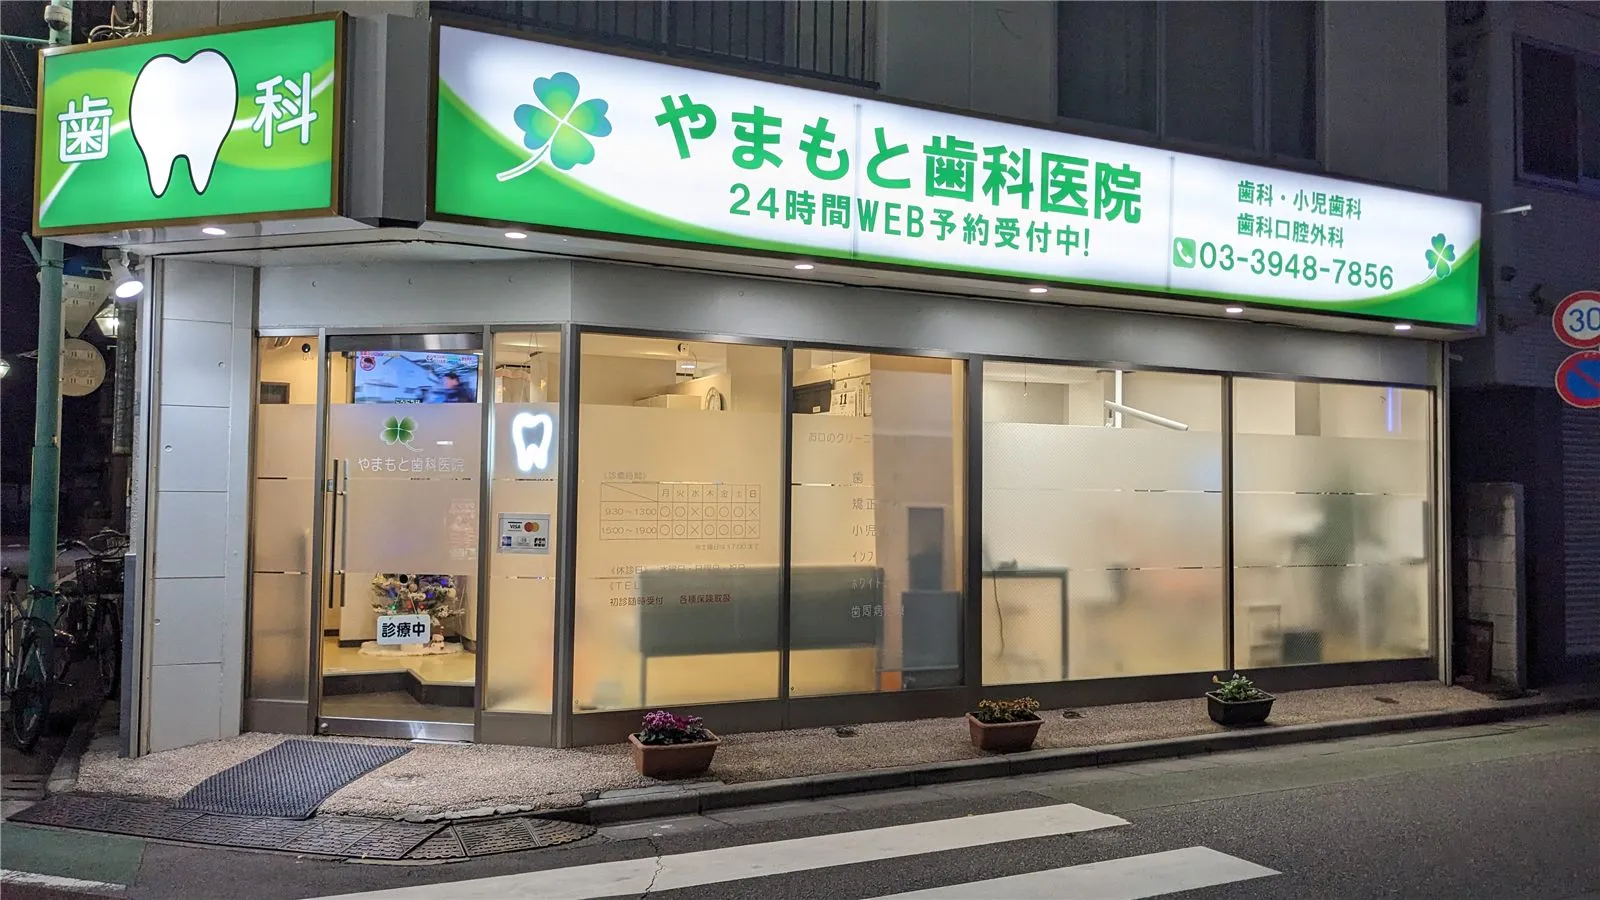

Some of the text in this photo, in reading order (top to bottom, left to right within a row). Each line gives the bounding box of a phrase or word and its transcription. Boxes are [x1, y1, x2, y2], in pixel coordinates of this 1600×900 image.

[57, 72, 318, 163] 歯 科
[655, 93, 1142, 224] やまもと歯科医院
[1237, 180, 1362, 220] 歯科・小児歯科
[1237, 212, 1344, 248] 歯科口腔外科
[1200, 242, 1394, 290] 03-3948-7856
[1569, 307, 1600, 332] 30
[358, 457, 465, 472] やまもと歯科医院
[381, 621, 426, 638] 診療中
